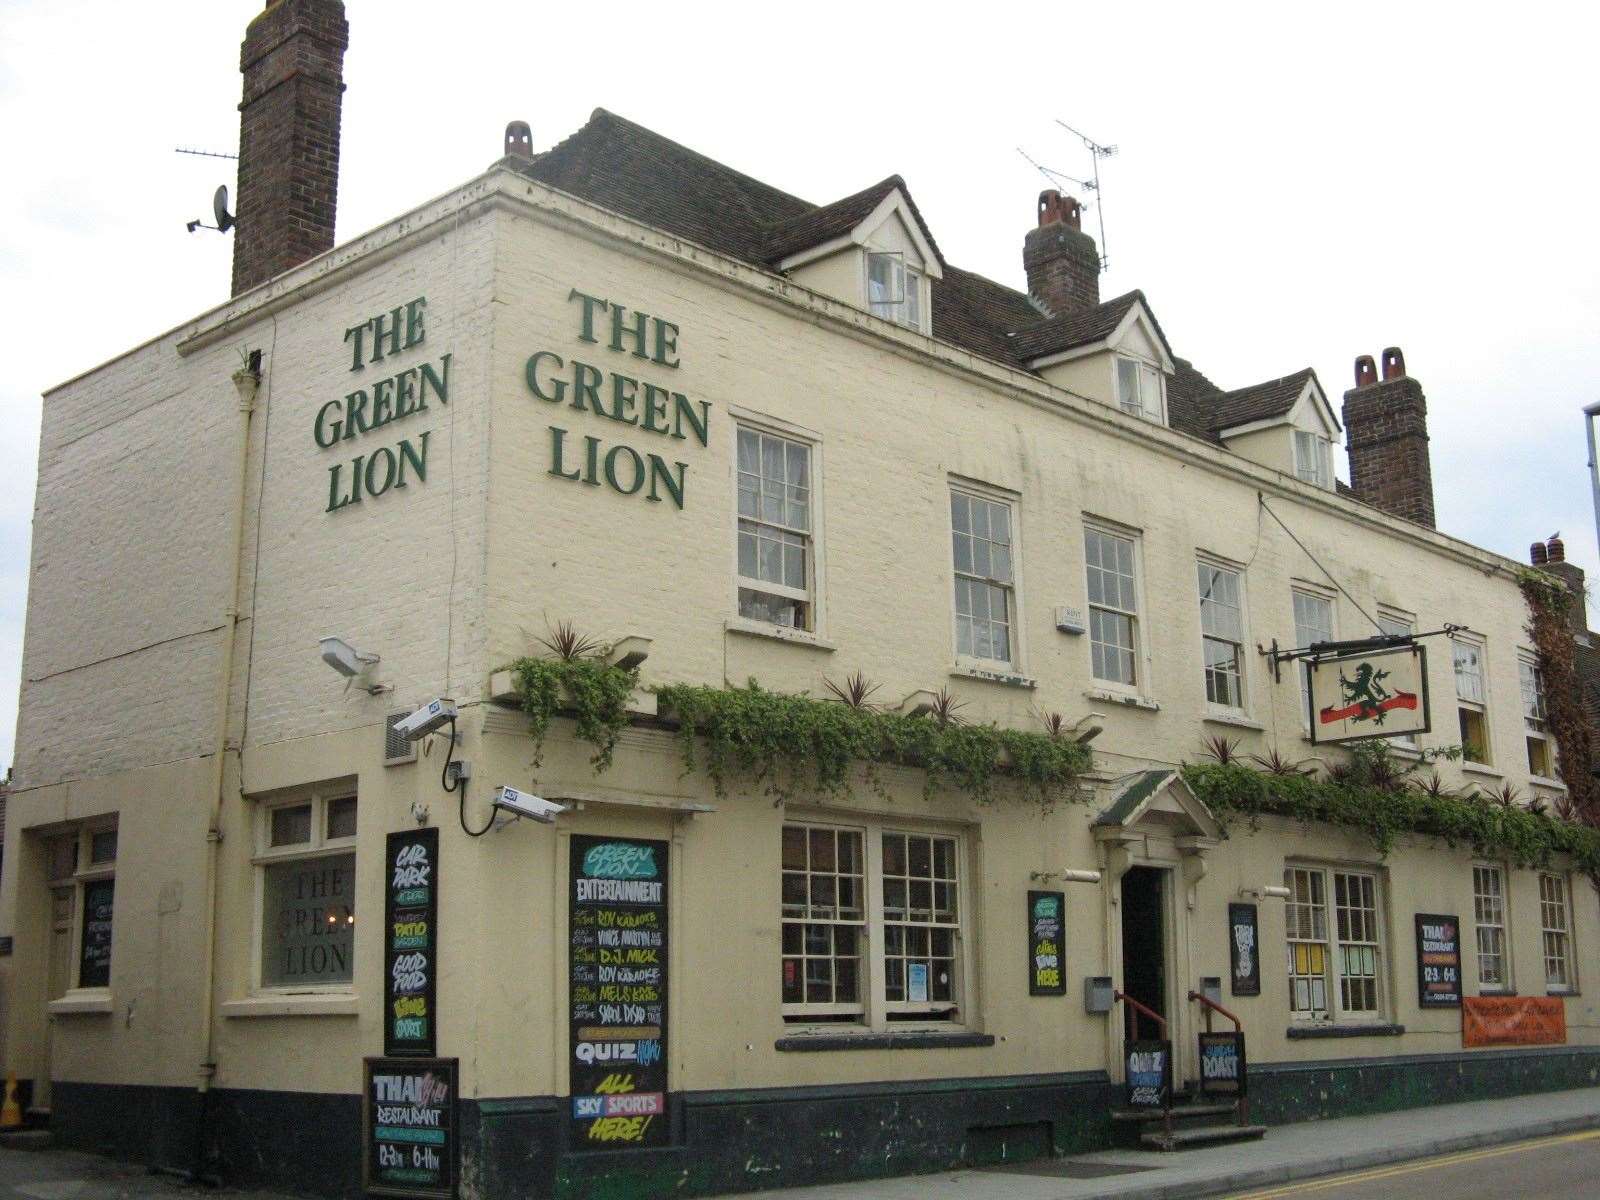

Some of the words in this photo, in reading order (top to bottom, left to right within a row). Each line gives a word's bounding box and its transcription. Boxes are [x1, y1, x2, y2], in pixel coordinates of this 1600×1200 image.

[343, 296, 427, 372] THE
[568, 288, 681, 369] THE
[313, 353, 453, 449] GREEN
[526, 350, 713, 447] GREEN
[325, 431, 432, 513] LION
[547, 426, 689, 510] LION
[396, 843, 428, 867] CAR
[587, 844, 653, 863] GREEN
[294, 869, 344, 900] THE
[393, 865, 431, 888] PARK
[576, 878, 664, 903] ENTERTAINMENT
[393, 921, 427, 938] PATIO
[616, 911, 657, 928] KARAOKE
[1422, 925, 1444, 940] THAI
[286, 943, 347, 976] LION
[392, 952, 427, 978] GOOD
[627, 949, 658, 963] MICK
[393, 971, 427, 993] FOOD
[598, 965, 617, 982] ROY
[617, 967, 660, 983] KARAOKE
[576, 1042, 637, 1065] QUIZ
[1129, 1051, 1162, 1074] QUIZ
[1202, 1055, 1239, 1078] ROAST
[373, 1075, 424, 1102] THAI
[595, 1073, 635, 1094] ALL
[377, 1105, 442, 1127] RESTAURANT
[577, 1098, 603, 1115] SKY
[608, 1095, 657, 1114] SPORTS
[588, 1115, 653, 1142] HERE!
